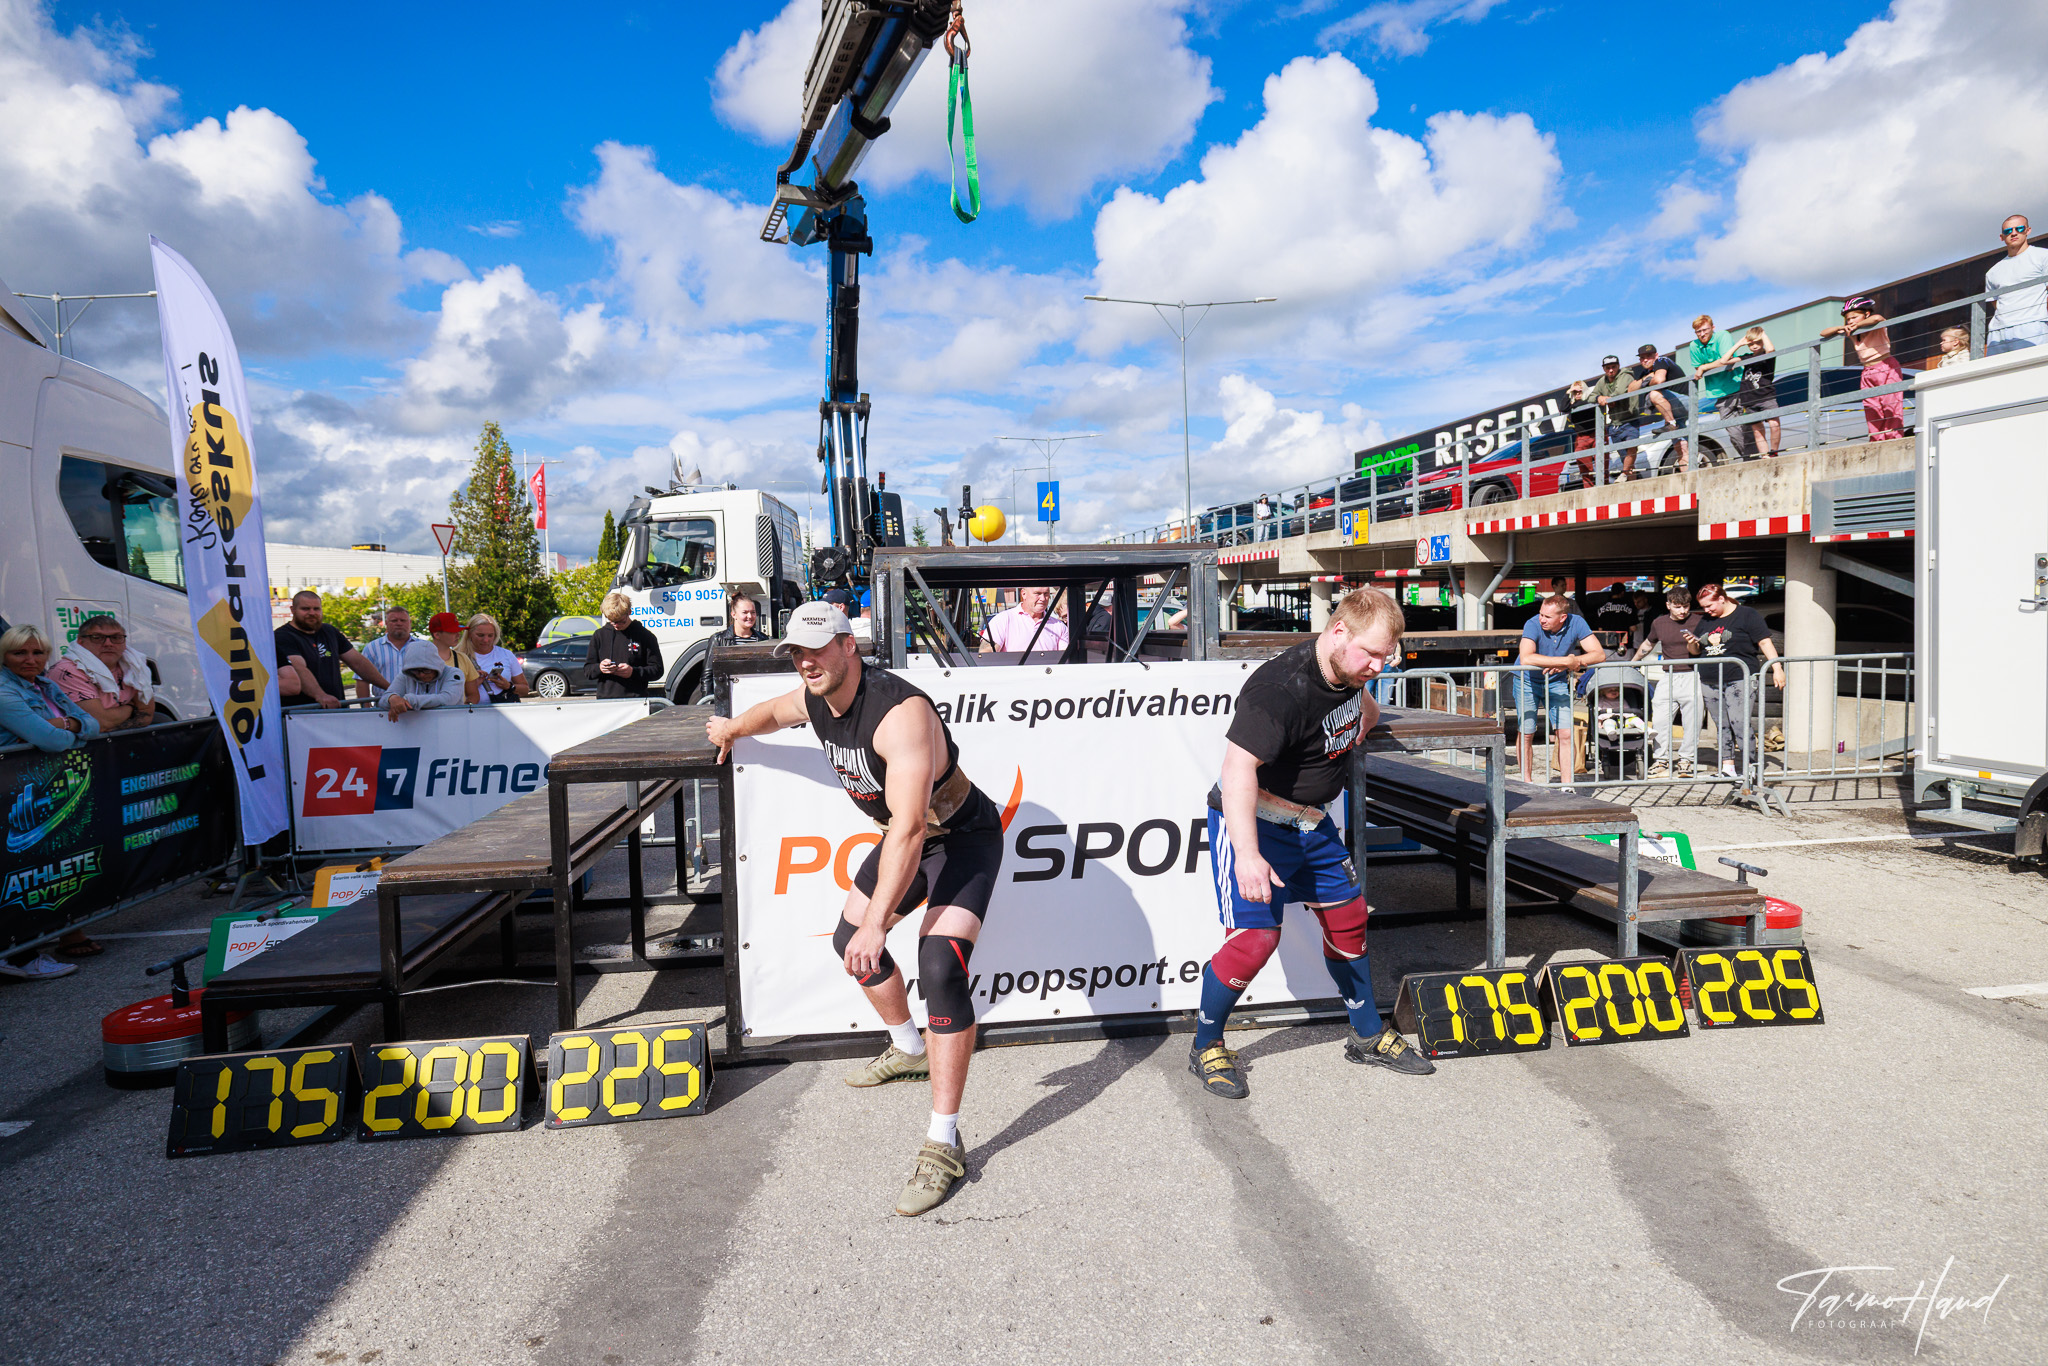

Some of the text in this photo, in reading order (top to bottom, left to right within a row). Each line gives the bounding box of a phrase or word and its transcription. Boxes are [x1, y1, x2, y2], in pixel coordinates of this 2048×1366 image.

[1435, 398, 1611, 466] RESERV
[1042, 491, 1055, 511] 4
[662, 589, 725, 602] 5560 9057
[936, 688, 1240, 728] alik spordivahen
[121, 762, 200, 796] ENGINEERING
[314, 758, 550, 798] 24 7 fitne
[122, 793, 178, 825] HUMAN
[5, 851, 96, 900] ATHLETE
[774, 833, 882, 895] PO
[28, 877, 77, 906] BYTES
[331, 889, 377, 899] POP SP
[229, 941, 257, 952] POP
[905, 956, 1210, 1004] .popsport.e
[1561, 962, 1685, 1038] 200
[1696, 950, 1820, 1022] 225
[1444, 972, 1544, 1045] 175
[211, 1050, 339, 1139] 175
[362, 1042, 520, 1130] 200
[551, 1027, 700, 1121] 225
